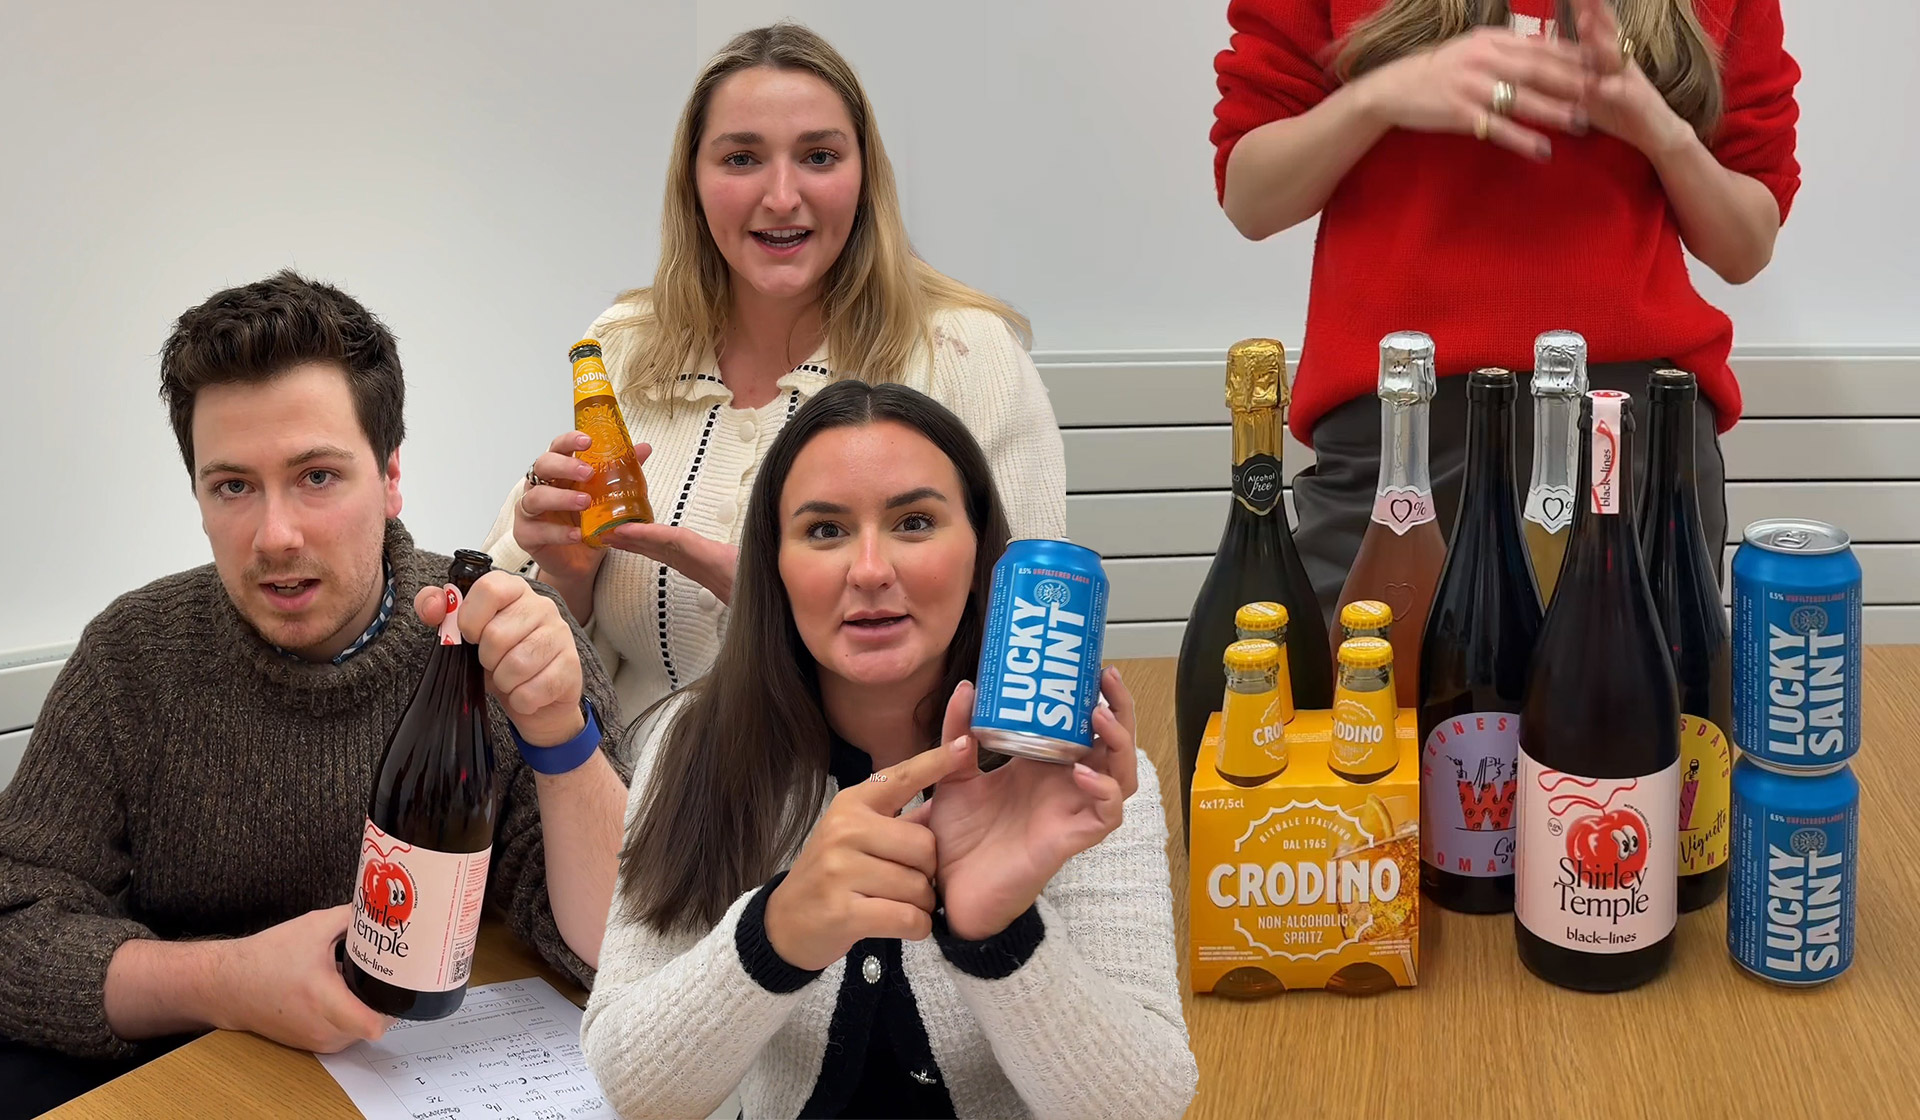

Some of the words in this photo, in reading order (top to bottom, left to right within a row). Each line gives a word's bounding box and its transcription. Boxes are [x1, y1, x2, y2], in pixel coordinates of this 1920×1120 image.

[573, 371, 609, 388] RODIN
[1246, 481, 1272, 499] free
[1248, 473, 1275, 482] Alcohol
[1033, 568, 1071, 580] UNFILTERED
[1072, 576, 1090, 584] LAGER
[999, 597, 1046, 723] LUCKY
[1037, 601, 1085, 731] SAINT
[1769, 623, 1805, 755] LUCKY
[1808, 629, 1844, 755] SAINT
[1199, 798, 1245, 810] 4x17,5cl
[1260, 818, 1300, 843] RITUALE
[1306, 816, 1352, 841] ITALIANO
[1283, 838, 1301, 850] DAL
[1304, 838, 1327, 849] 1965
[1680, 808, 1726, 863] Vignette
[1558, 857, 1647, 892] Shirley
[1690, 843, 1728, 870] INE
[1207, 859, 1402, 909] CRODINO
[1553, 882, 1648, 924] Temple
[358, 887, 410, 938] Shirley
[1257, 915, 1349, 930] NON-ALCOHOLIC
[1767, 845, 1804, 971] LUCKY
[1807, 850, 1843, 972] SAINT
[353, 904, 409, 957] Temple
[1283, 932, 1323, 945] SPRITZ
